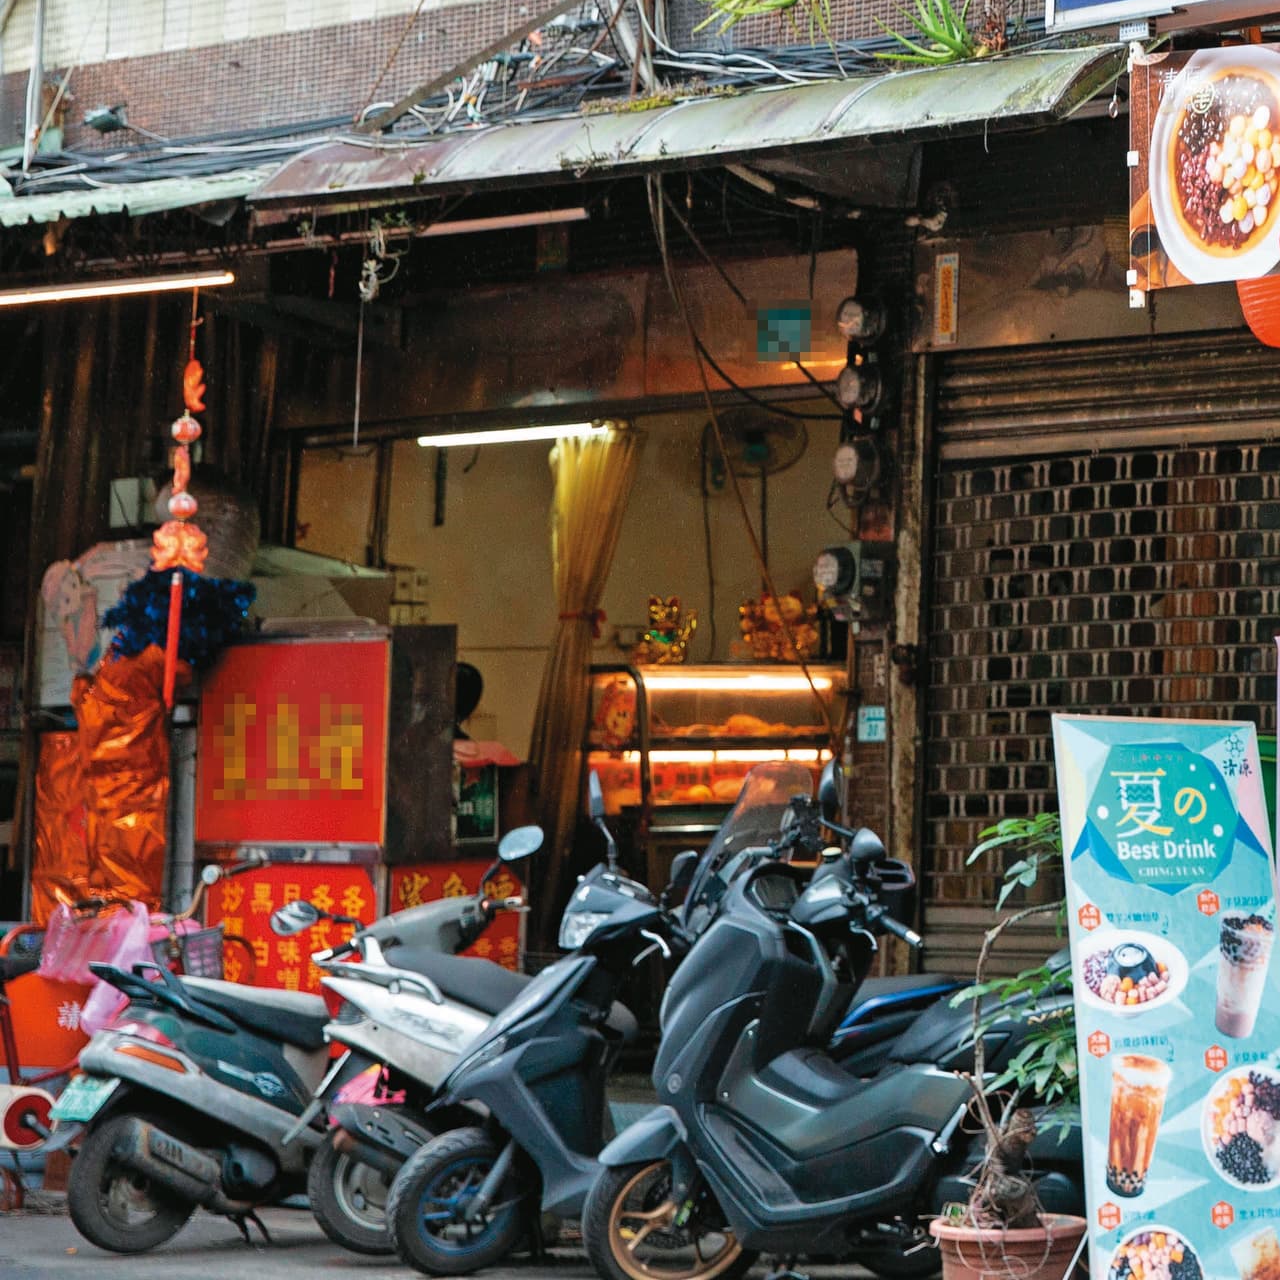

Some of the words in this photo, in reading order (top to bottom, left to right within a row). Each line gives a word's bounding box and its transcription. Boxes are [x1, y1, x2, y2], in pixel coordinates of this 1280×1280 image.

[1110, 768, 1207, 838] 夏の
[1117, 841, 1160, 860] Best
[1164, 838, 1217, 859] Drink
